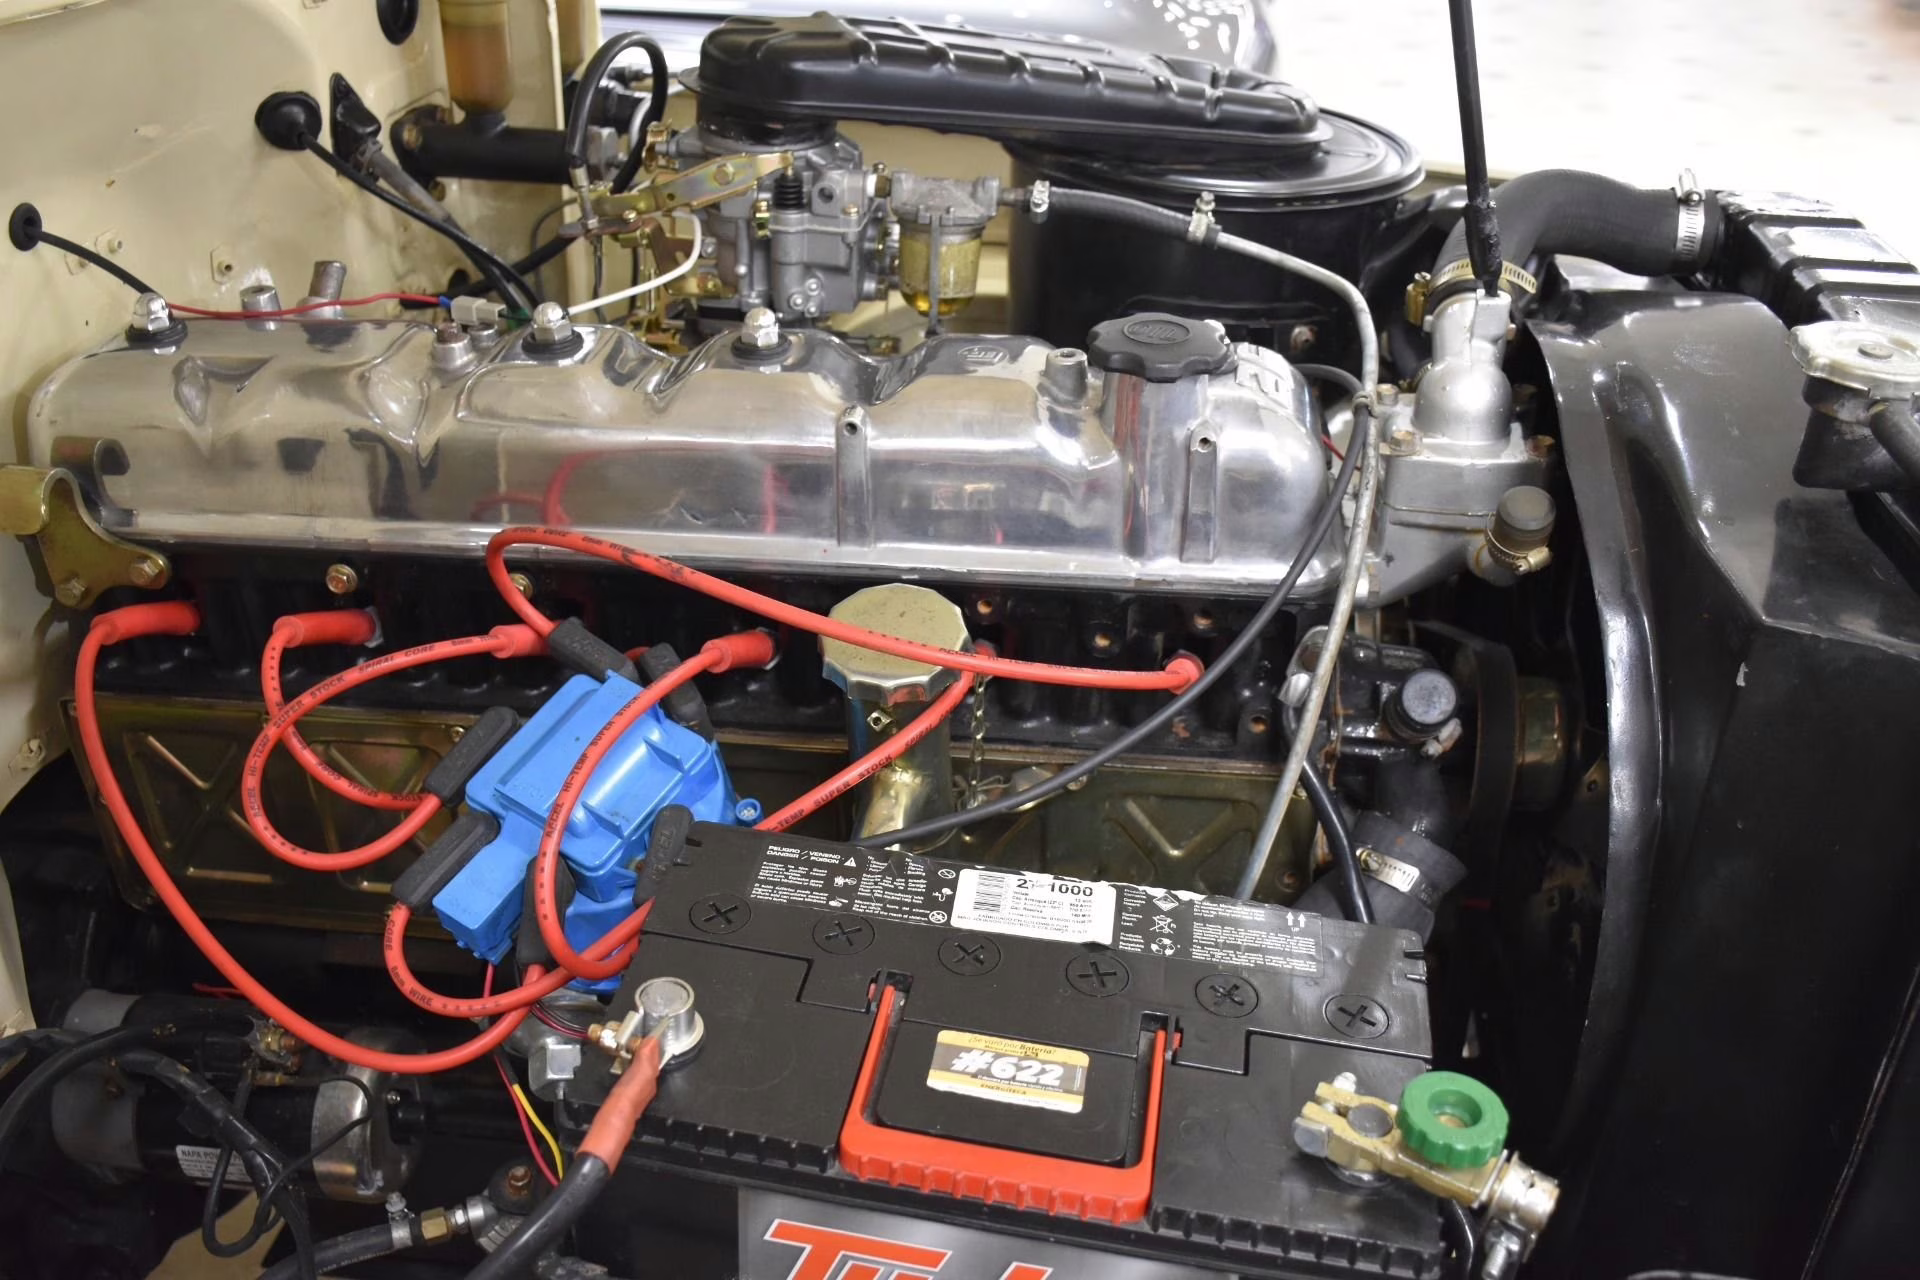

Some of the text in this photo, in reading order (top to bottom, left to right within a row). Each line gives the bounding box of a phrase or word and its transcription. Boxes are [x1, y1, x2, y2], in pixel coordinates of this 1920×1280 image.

[310, 674, 346, 700] STOCK
[545, 802, 565, 839] ACCEL
[562, 751, 590, 793] HI-TEMP
[813, 780, 851, 808] SUPER
[857, 753, 894, 780] STOCK
[766, 850, 800, 859] DANGER
[810, 856, 840, 864] POISON
[809, 851, 841, 860] VENENO
[386, 920, 396, 951] CORE
[408, 986, 434, 1008] WIRE
[950, 1048, 1065, 1087] #622
